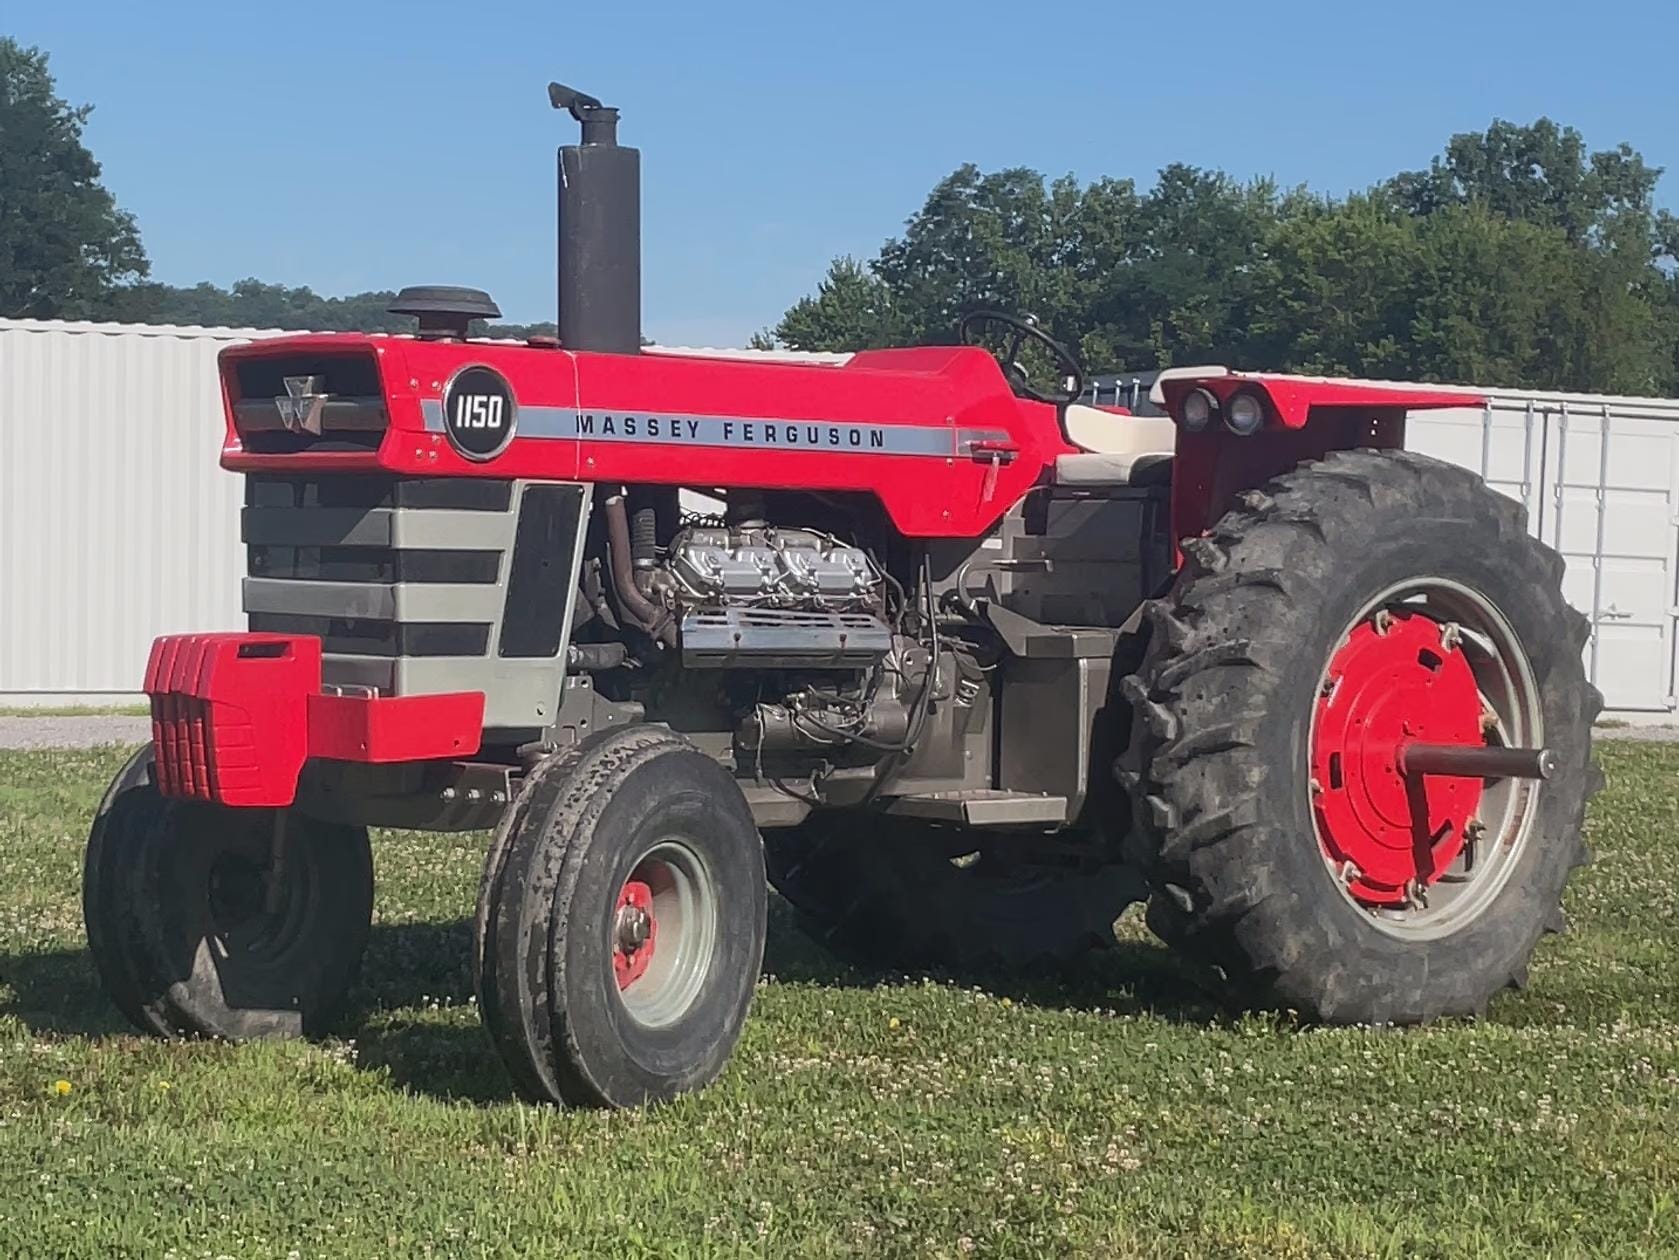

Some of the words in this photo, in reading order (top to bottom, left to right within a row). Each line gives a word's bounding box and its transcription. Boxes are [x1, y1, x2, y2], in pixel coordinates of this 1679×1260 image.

[456, 394, 503, 428] 1150
[576, 415, 699, 439] MASSEY
[724, 423, 884, 447] FERGUSON
